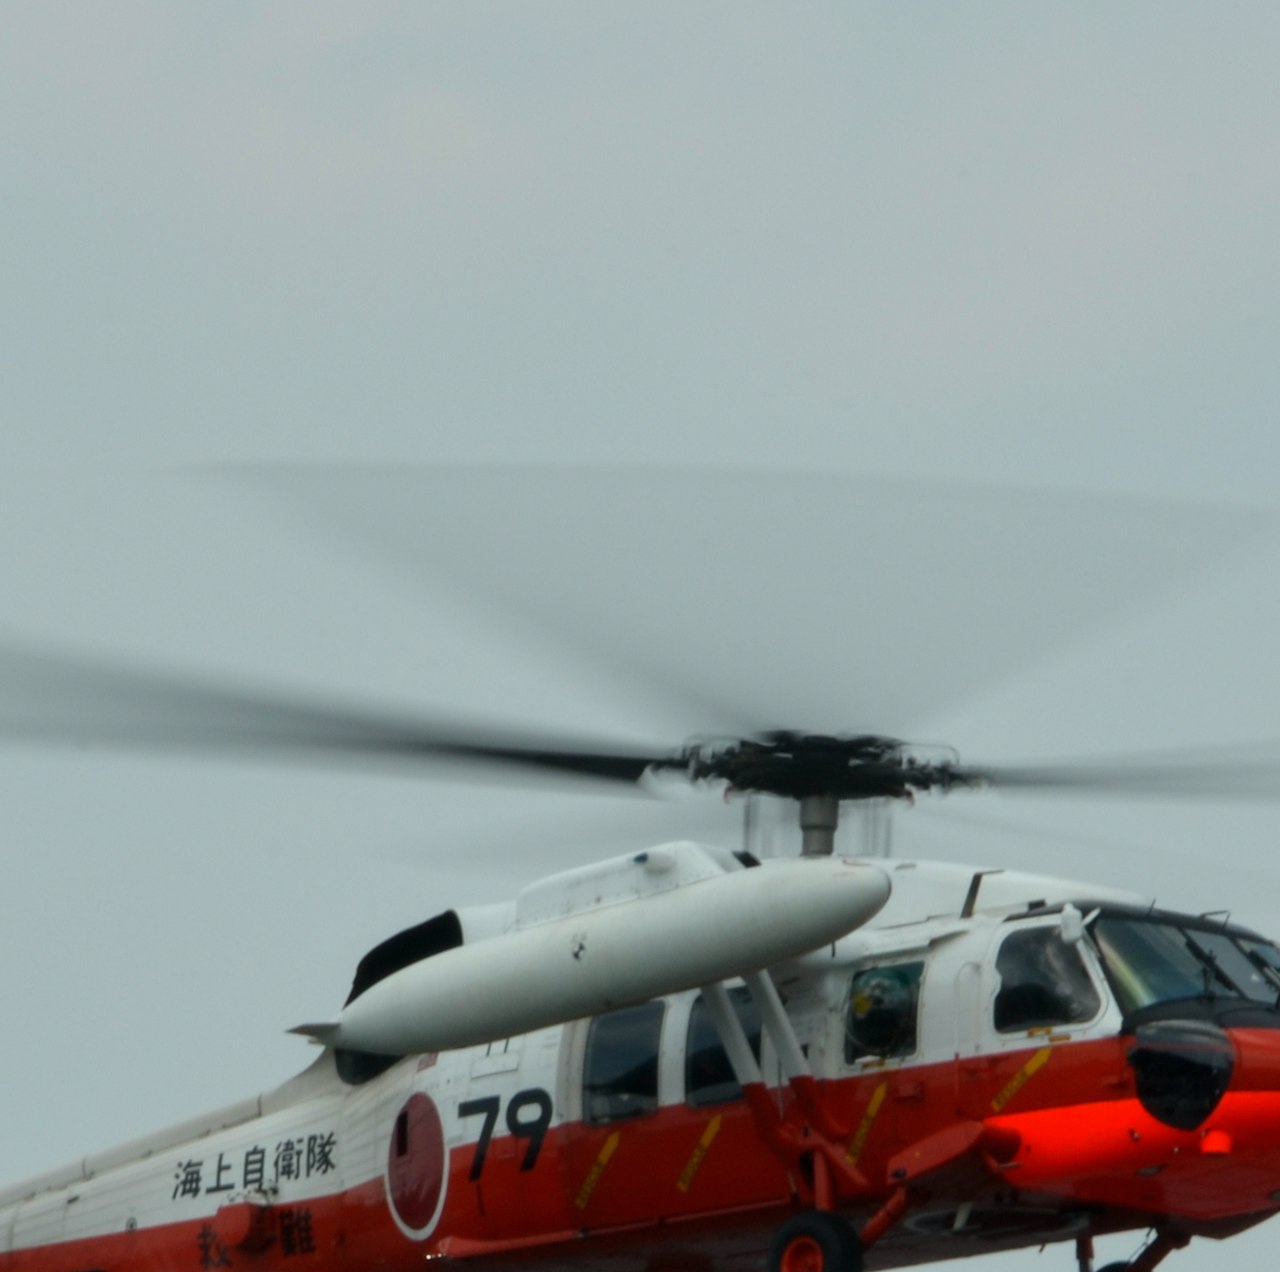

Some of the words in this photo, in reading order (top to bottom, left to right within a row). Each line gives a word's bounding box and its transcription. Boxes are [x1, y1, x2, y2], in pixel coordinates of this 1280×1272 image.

[172, 1131, 337, 1201] 海上自衛隊
[458, 1086, 554, 1182] 79
